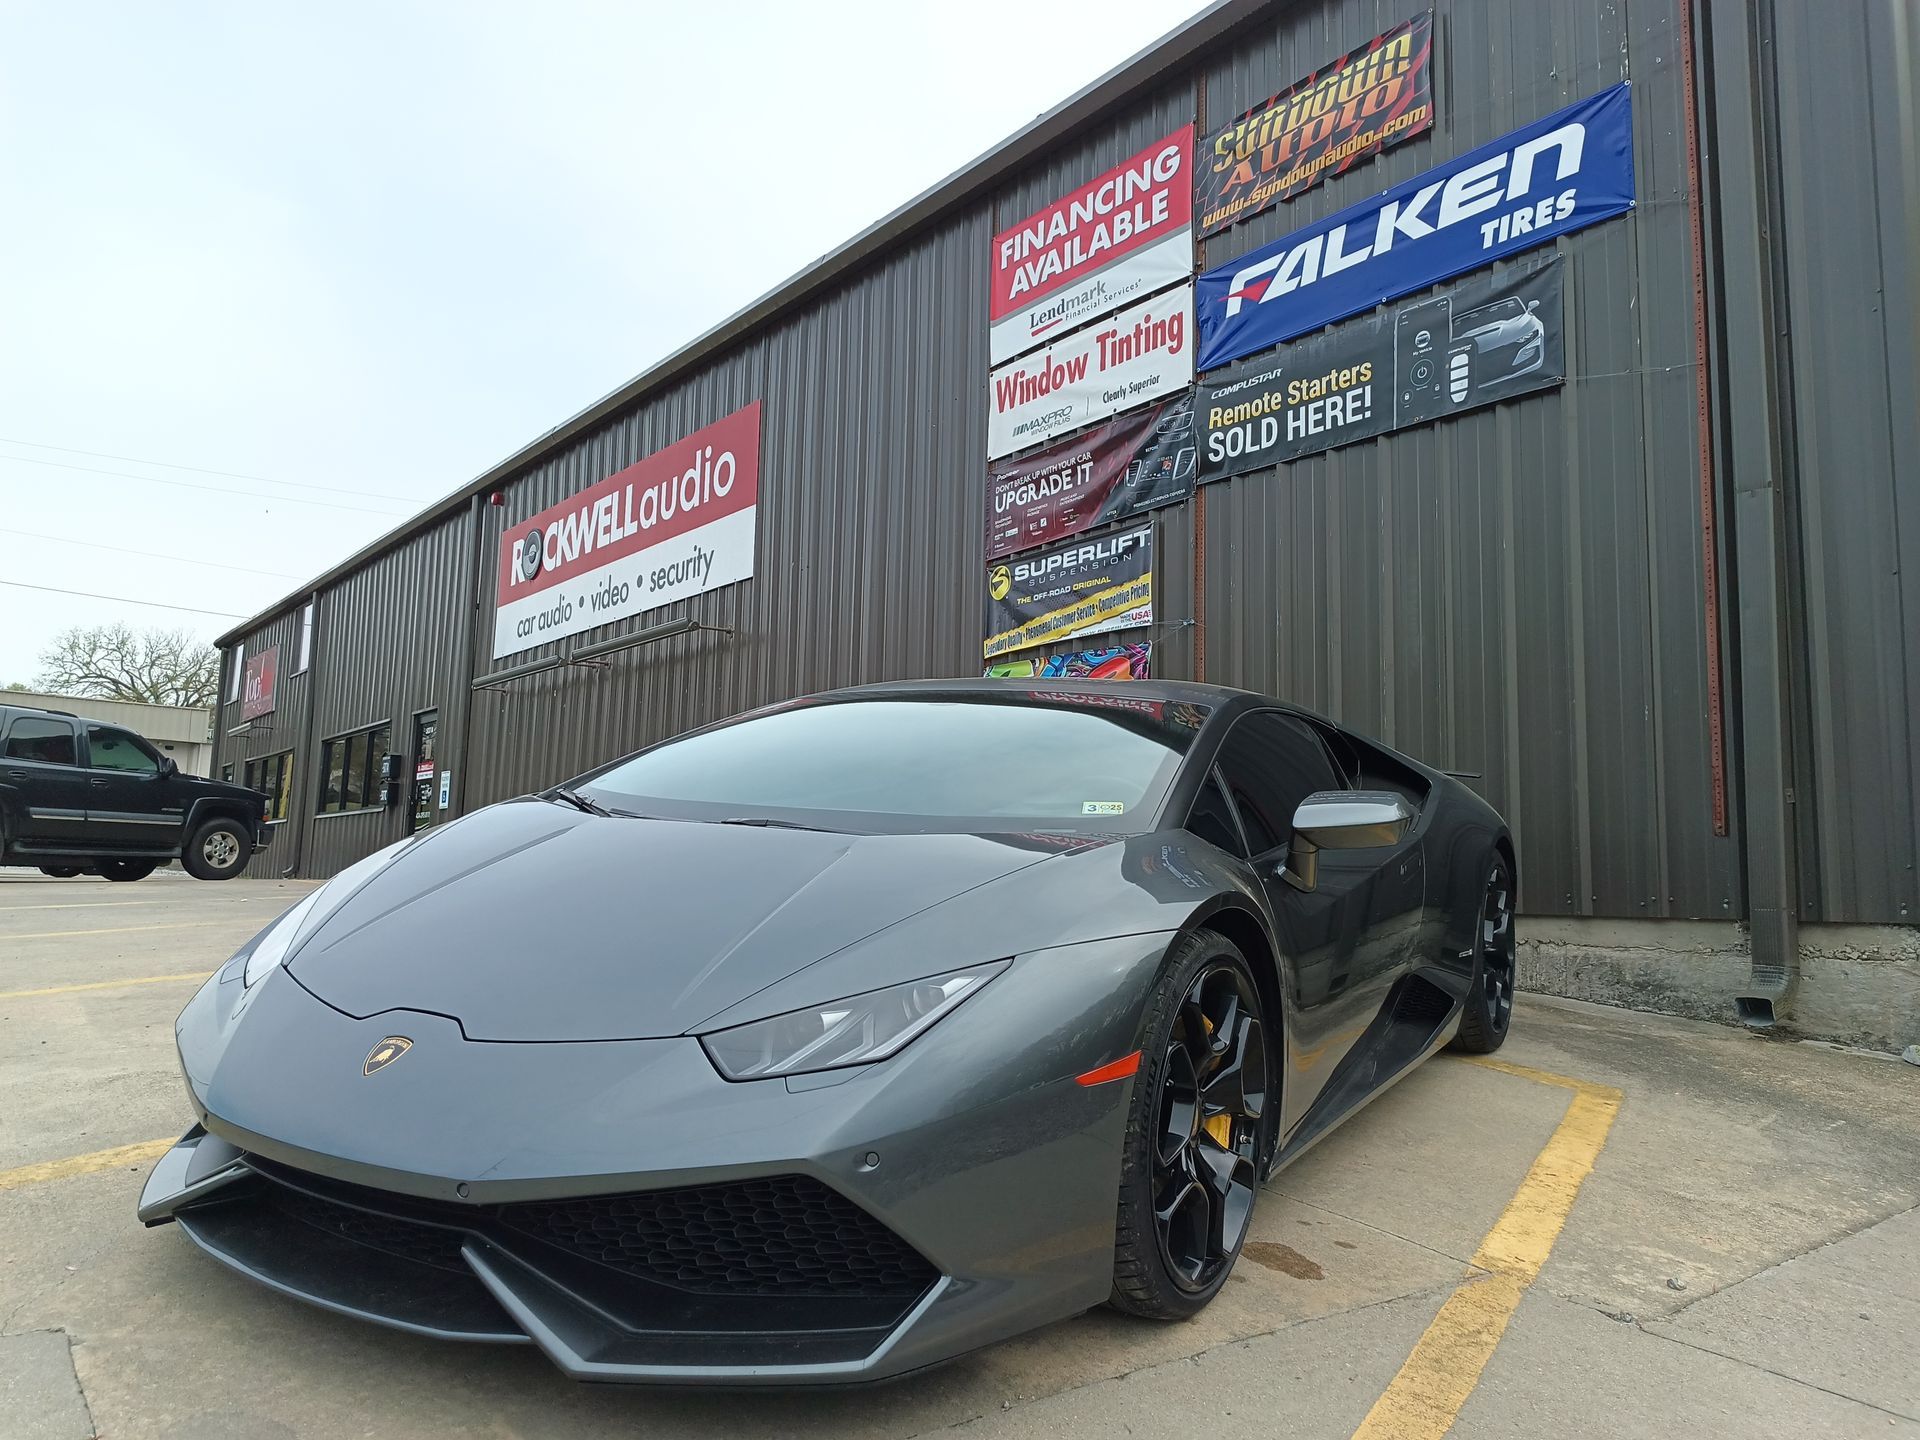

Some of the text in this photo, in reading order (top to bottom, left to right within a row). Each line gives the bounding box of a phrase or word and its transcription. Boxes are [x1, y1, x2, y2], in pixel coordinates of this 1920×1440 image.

[1203, 105, 1427, 228] www.sundownaudio.com
[1000, 145, 1181, 270] FINANCING
[1480, 188, 1577, 249] TIRES
[1009, 188, 1169, 300] AVAILABLE
[1029, 280, 1106, 329] Lendmark
[1065, 298, 1100, 321] Financial
[996, 311, 1184, 414] Window Tinting
[1211, 367, 1283, 400] COMPUSTAR
[1102, 373, 1161, 405] Clearly Superior
[1208, 361, 1373, 430] Remote Starters
[1022, 405, 1073, 433] MAXPRO
[1208, 385, 1372, 463] SOLD HERE!
[995, 451, 1092, 494] DON'T BREAK UP WITH YOUR CAR
[995, 461, 1094, 513] UPGRADE IT
[996, 469, 1020, 482] Pioneer
[1014, 530, 1151, 582] SUPERLIFT
[1029, 552, 1132, 587] SUSPENSION
[517, 544, 714, 637] car audio video security
[1016, 575, 1112, 605] THE OFF-ROAD ORIGINAL
[1076, 603, 1095, 620] Service
[1131, 610, 1149, 621] USA
[1087, 804, 1097, 812] 3
